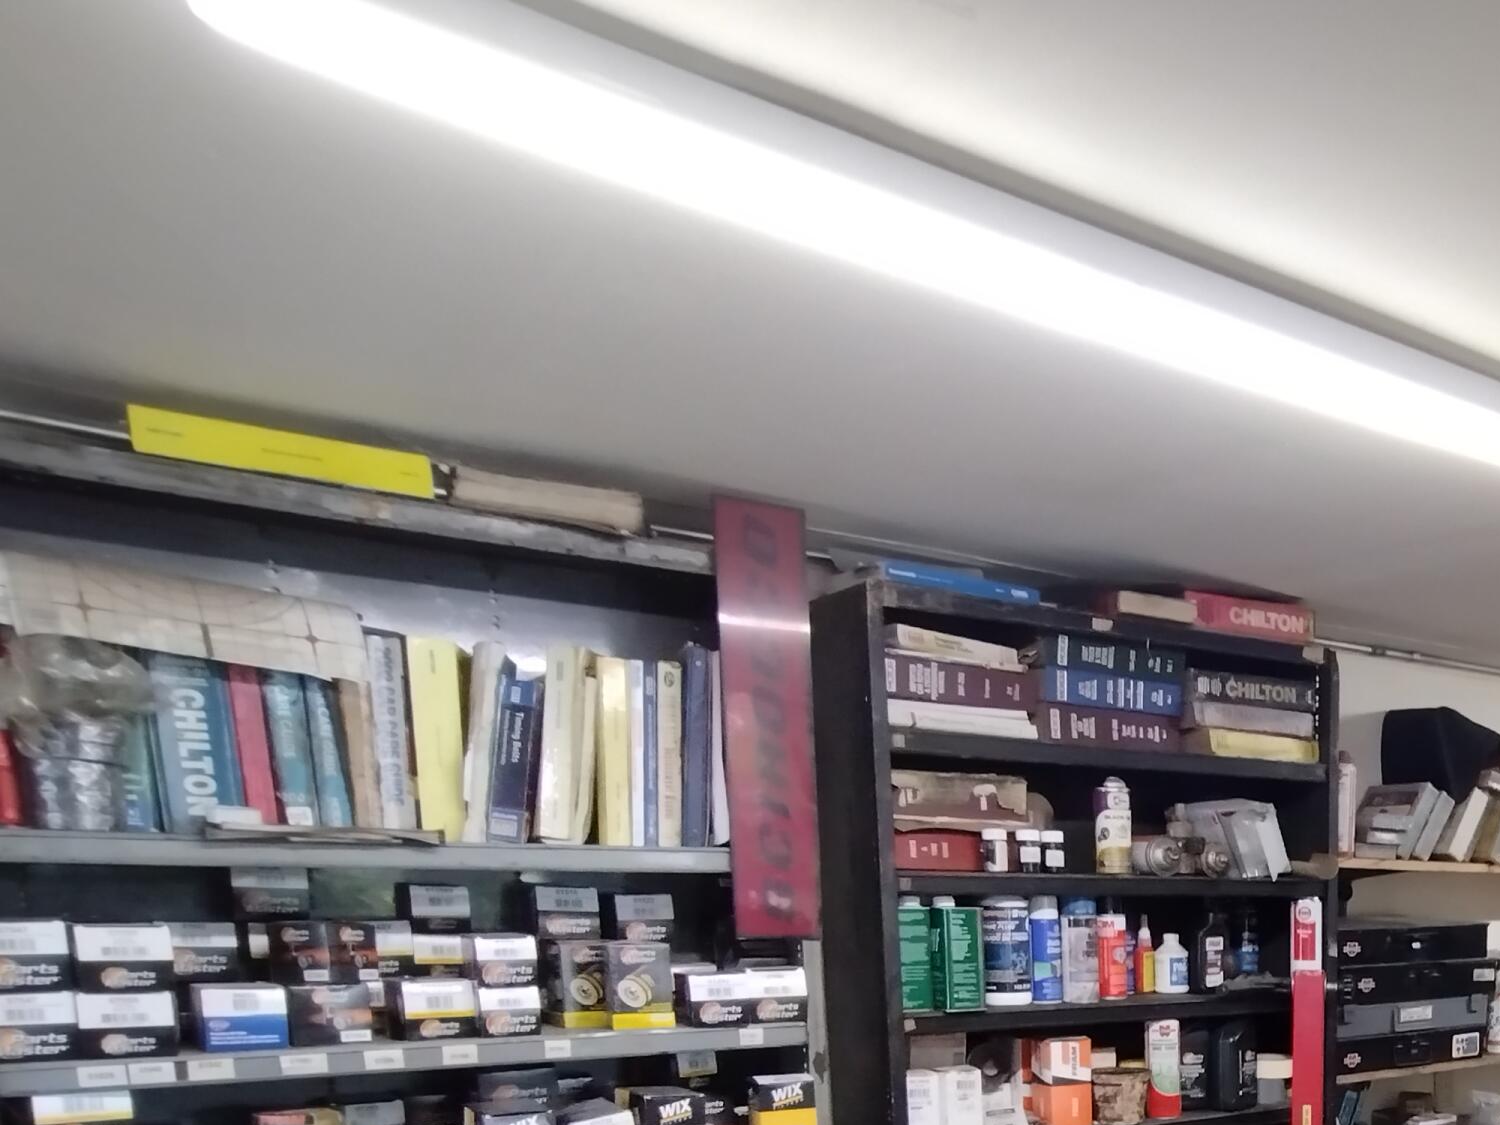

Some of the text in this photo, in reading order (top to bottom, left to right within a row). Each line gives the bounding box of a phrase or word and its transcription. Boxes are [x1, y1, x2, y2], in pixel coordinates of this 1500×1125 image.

[1228, 606, 1305, 634] CHILTON
[1225, 679, 1297, 702] CHILTON
[510, 712, 524, 764] Timing Belts
[169, 687, 219, 818] CHILTON
[1070, 1045, 1079, 1077] FRAM
[771, 1082, 804, 1104] WIX
[658, 1098, 692, 1120] WIX
